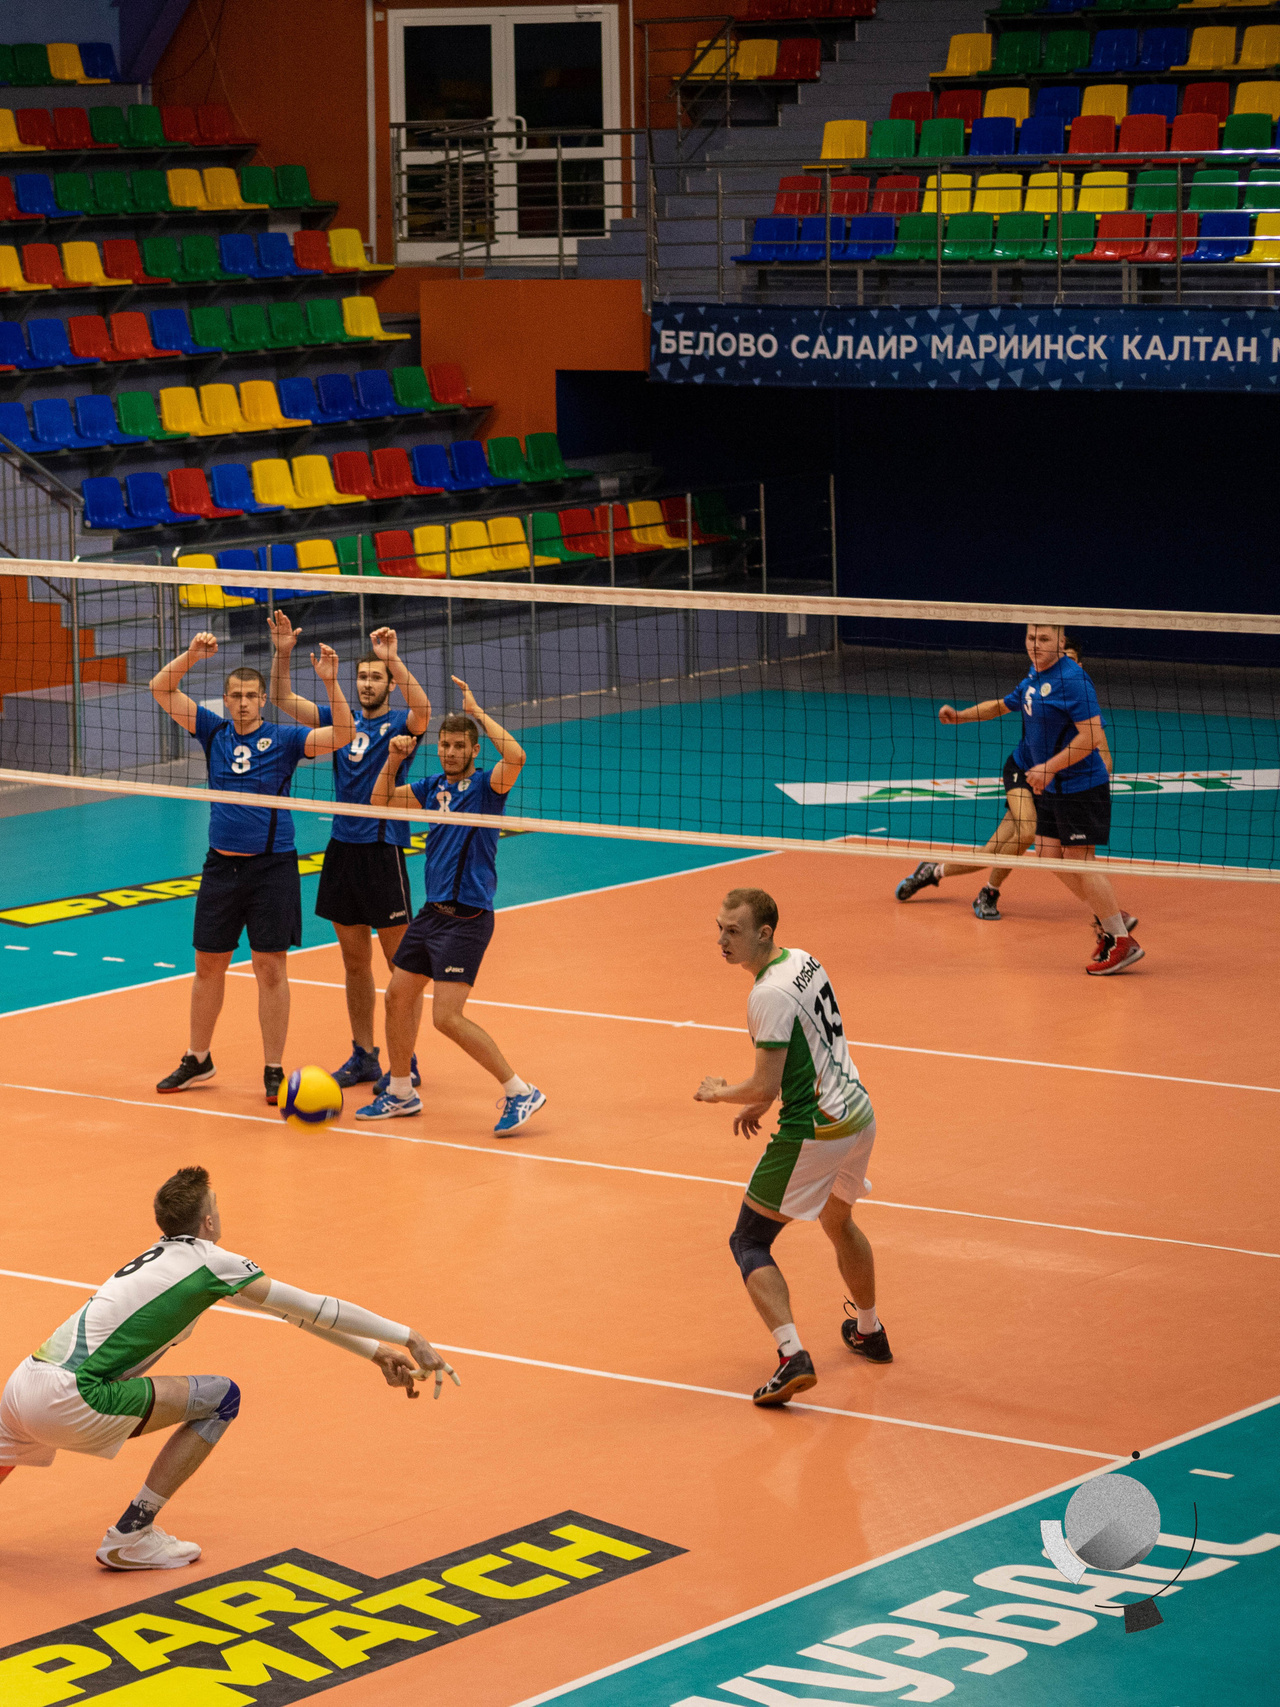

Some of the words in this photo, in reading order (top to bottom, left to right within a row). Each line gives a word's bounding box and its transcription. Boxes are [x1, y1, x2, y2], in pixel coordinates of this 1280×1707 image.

[659, 329, 778, 358] БЕЛОВО
[790, 334, 918, 360] САЛАИР
[930, 334, 1108, 361] МАРИИНСК
[1122, 335, 1258, 362] КАЛТАН
[230, 745, 253, 774] 3
[348, 731, 370, 762] 9
[814, 981, 843, 1048] 13
[114, 1246, 164, 1279] 8
[64, 1524, 652, 1707] MATCH
